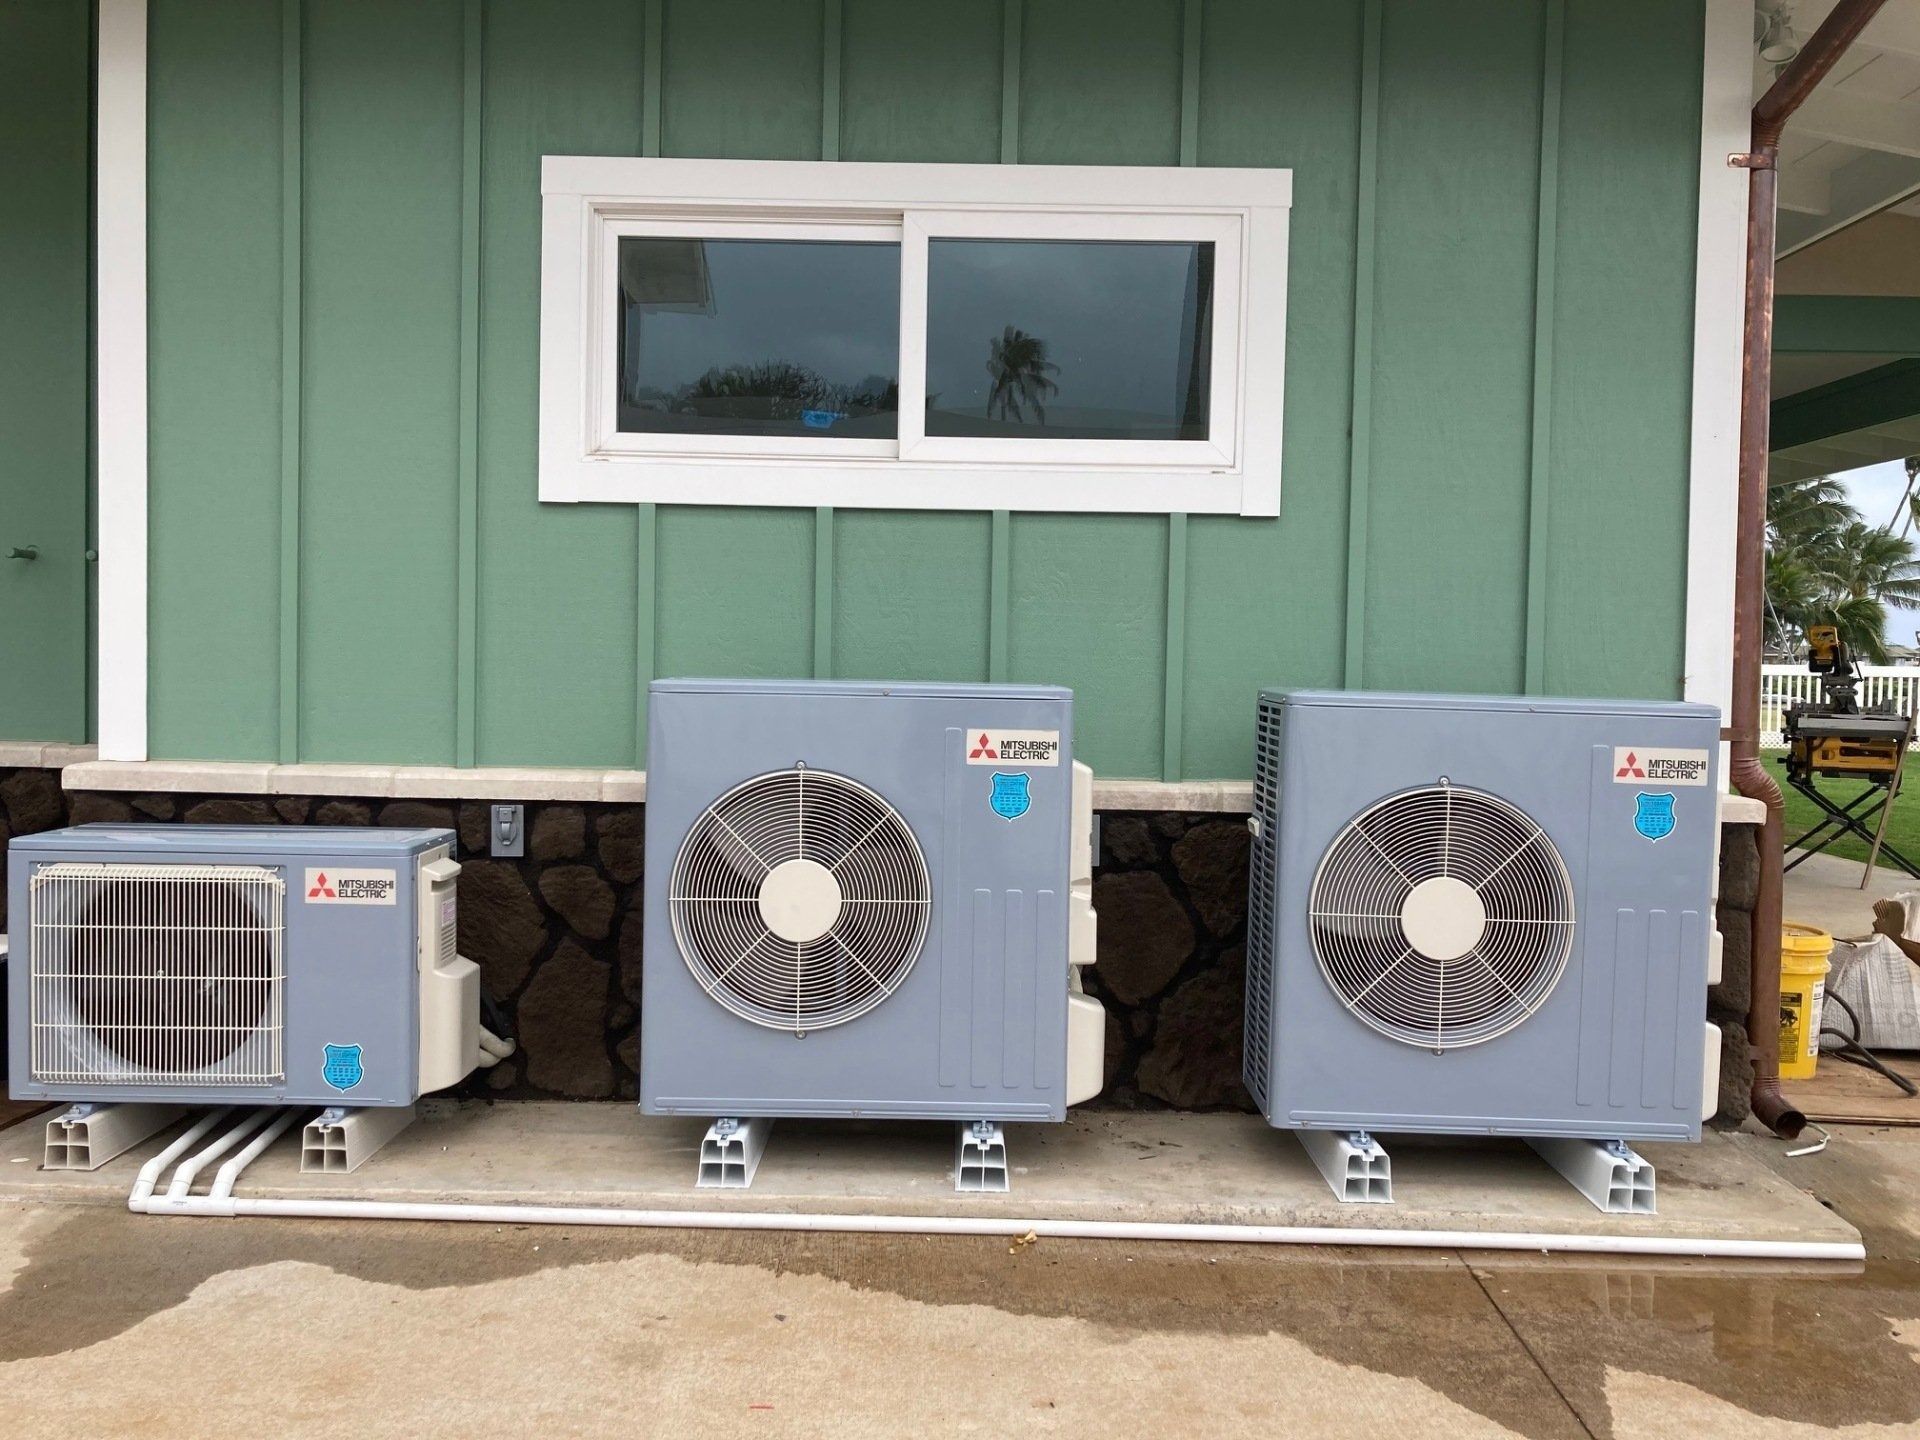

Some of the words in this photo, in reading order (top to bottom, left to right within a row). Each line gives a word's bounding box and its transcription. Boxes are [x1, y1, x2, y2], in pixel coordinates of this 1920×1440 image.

[1000, 740, 1057, 751] MITSUBISHI
[1000, 750, 1050, 760] ELECTRIC
[1648, 759, 1706, 770] MITSUBISHI
[1648, 769, 1698, 780] ELECTRIC
[338, 879, 394, 889] MITSUBISHI
[338, 889, 386, 899] ELECTRIC
